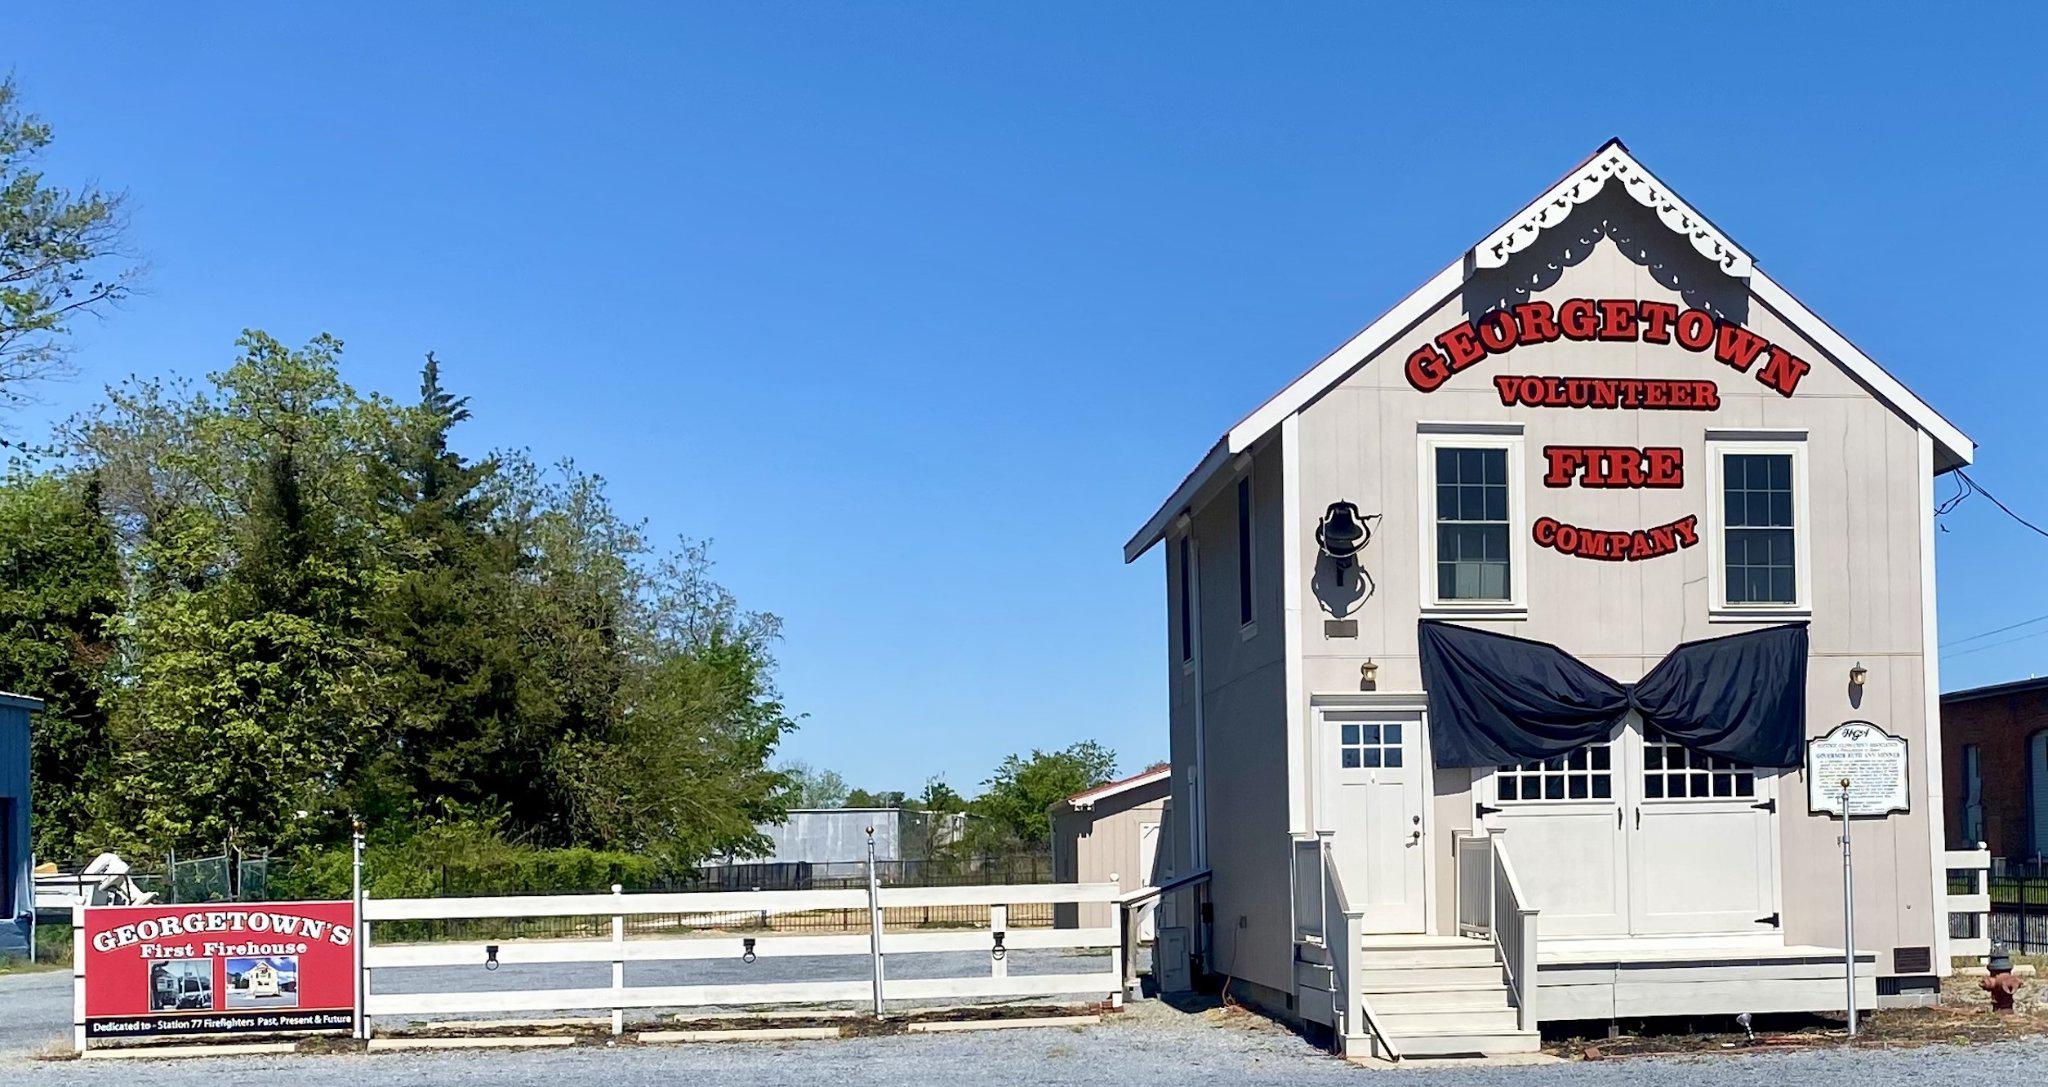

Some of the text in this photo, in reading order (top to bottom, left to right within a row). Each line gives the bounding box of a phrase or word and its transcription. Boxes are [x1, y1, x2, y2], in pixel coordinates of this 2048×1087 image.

[1405, 299, 1810, 398] GEORGETOWN
[1494, 375, 1720, 411] VOLUNTEER
[1543, 445, 1684, 488] FIRE
[1532, 515, 1699, 561] COMPANY
[92, 911, 352, 952] GEORGETOWN'S
[140, 941, 308, 958] First Firehouse
[93, 1021, 140, 1032] Dedicated
[141, 1021, 152, 1031] to
[157, 1019, 189, 1030] Station
[191, 1019, 203, 1028] 77
[203, 1016, 255, 1030] Firefighters
[257, 1016, 279, 1027] Past,
[280, 1015, 313, 1026] Present
[314, 1014, 322, 1024] &
[323, 1014, 352, 1024] Future
